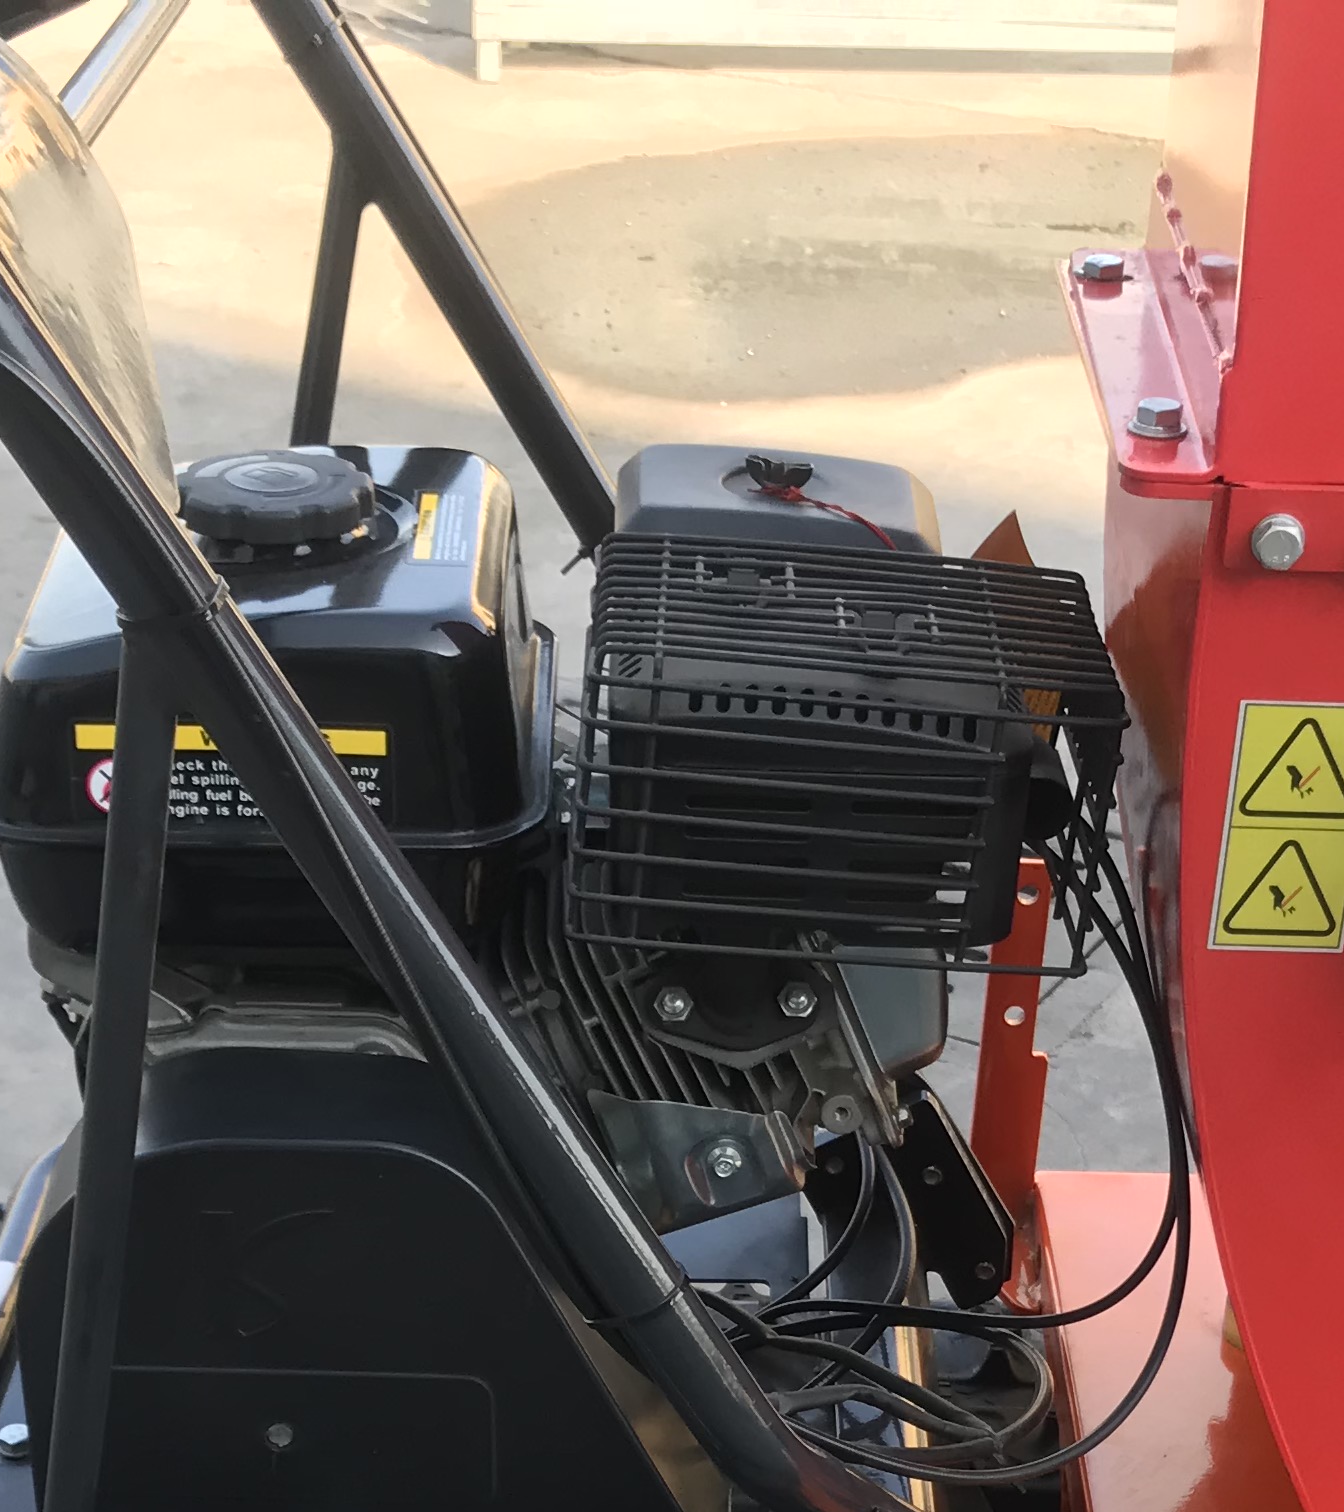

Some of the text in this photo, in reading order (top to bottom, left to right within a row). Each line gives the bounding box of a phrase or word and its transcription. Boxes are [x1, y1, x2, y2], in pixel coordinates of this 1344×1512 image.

[212, 760, 233, 771] th
[350, 766, 379, 779] any
[191, 773, 245, 787] spillin
[205, 789, 232, 801] fuel
[168, 805, 209, 818] ngine
[216, 803, 230, 816] is
